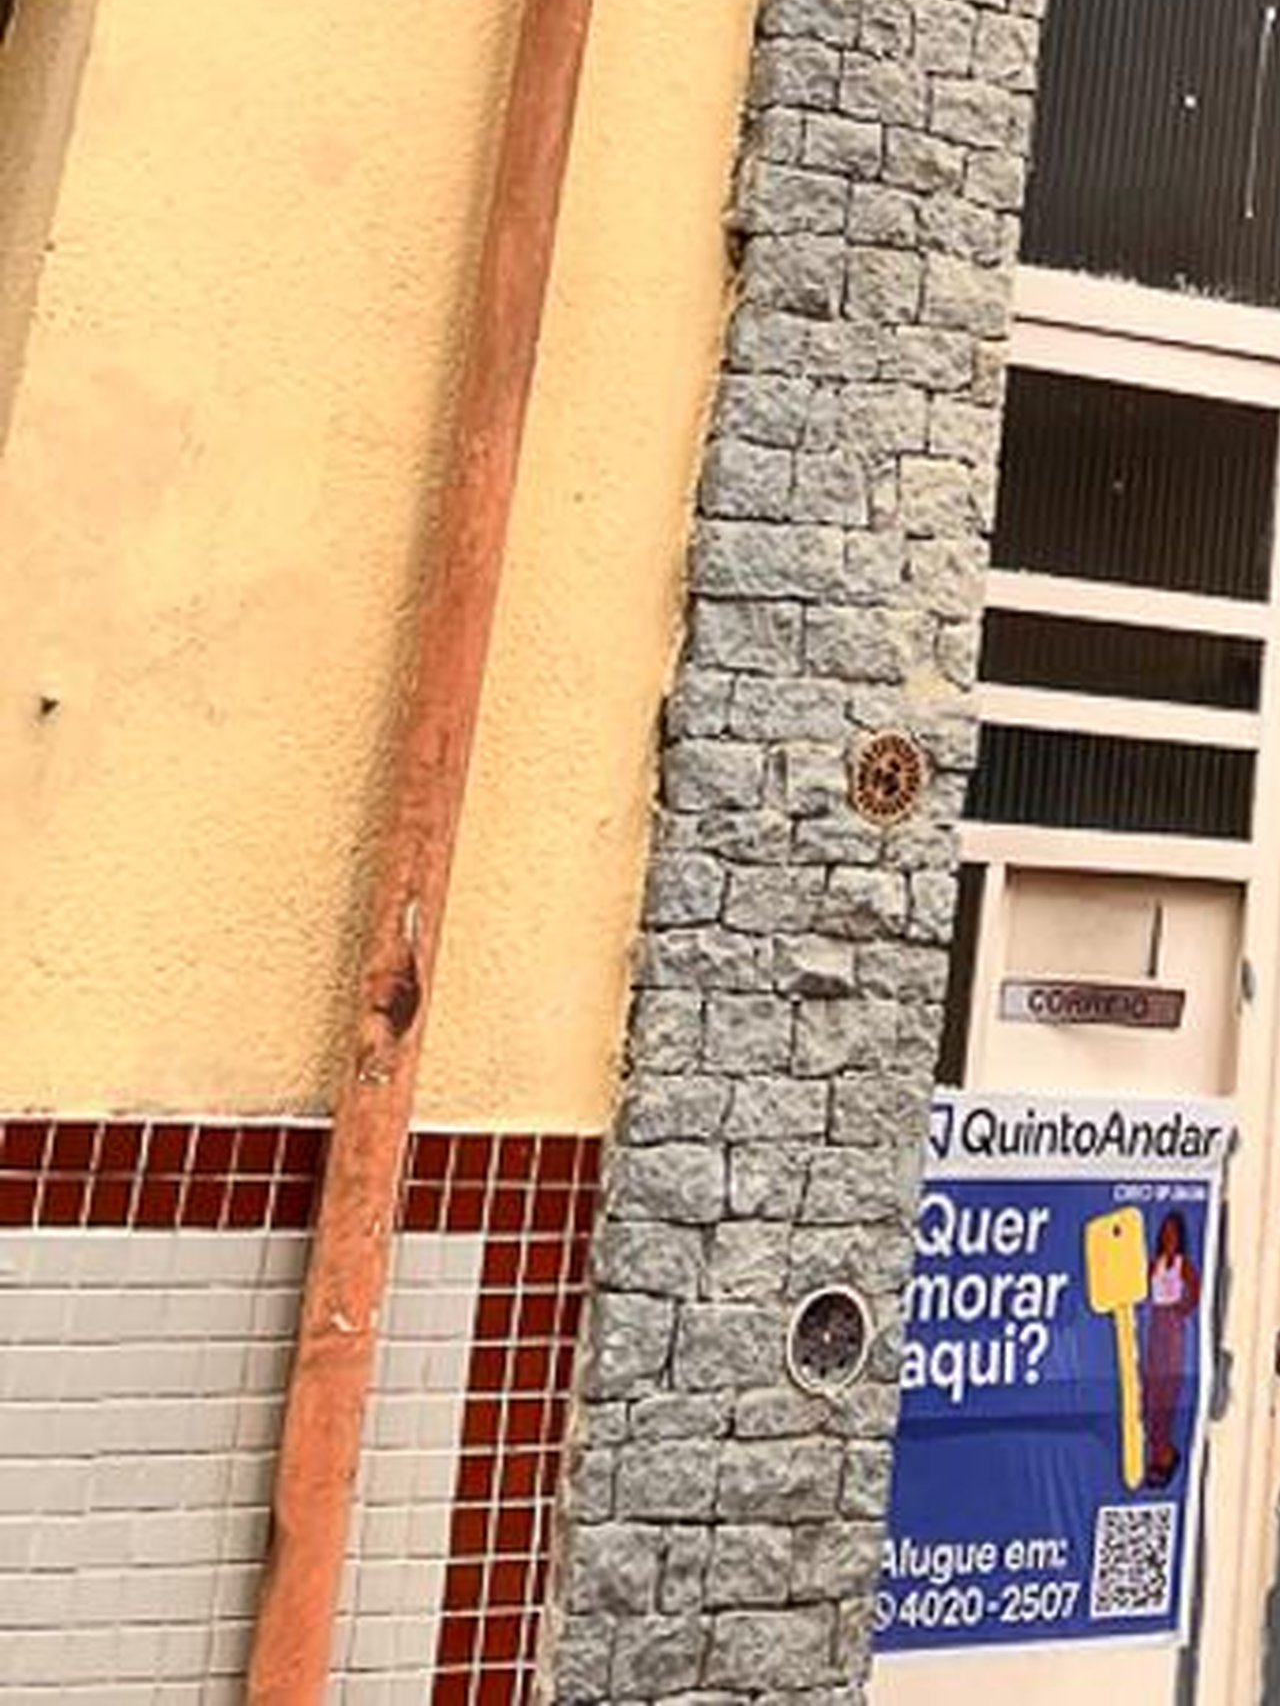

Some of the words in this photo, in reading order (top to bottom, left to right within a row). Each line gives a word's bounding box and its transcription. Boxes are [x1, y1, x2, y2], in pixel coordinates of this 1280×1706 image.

[961, 1108, 1221, 1159] QuintoAndar
[915, 1193, 1049, 1256] Quer
[902, 1271, 1068, 1322] morar
[900, 1323, 1049, 1403] aqui?
[1004, 1538, 1068, 1572] em:
